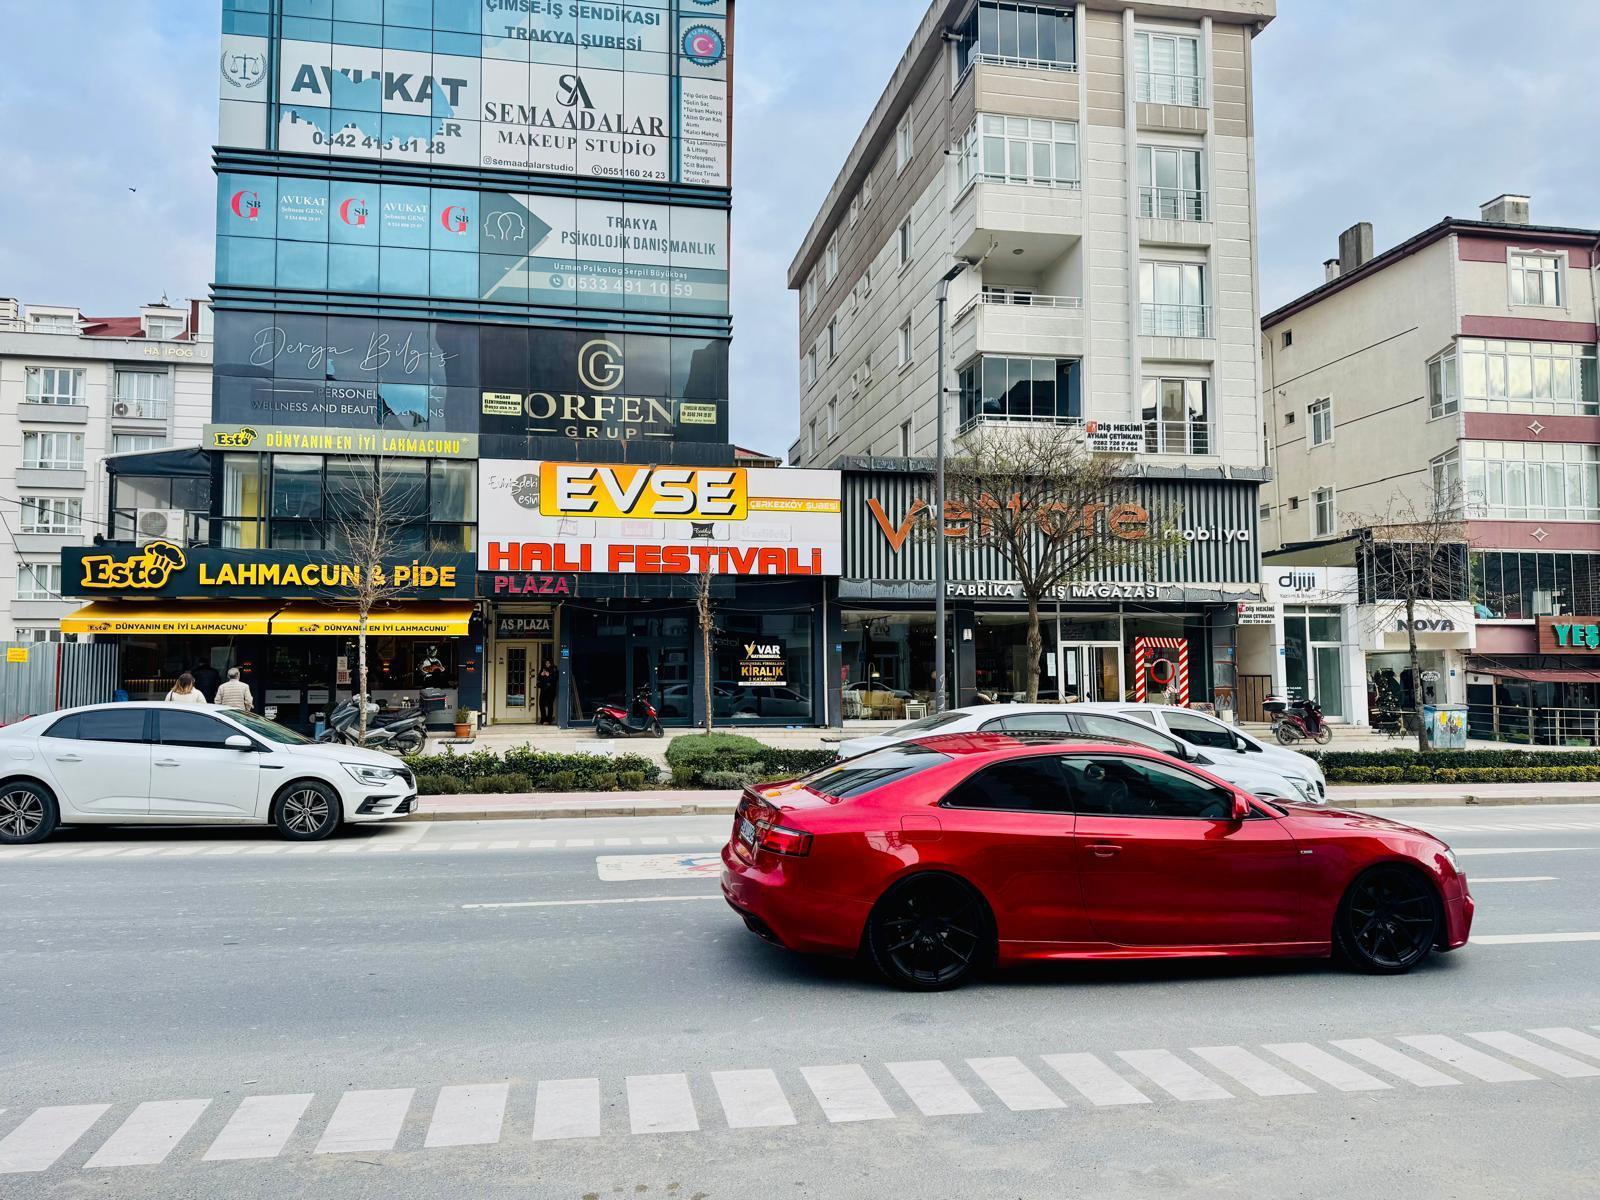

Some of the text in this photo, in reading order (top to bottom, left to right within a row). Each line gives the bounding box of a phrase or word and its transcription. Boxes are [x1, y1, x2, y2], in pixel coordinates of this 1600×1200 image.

[569, 4, 661, 26] SENDİKASI
[504, 26, 642, 51] TRAKYA ŞUBESİ
[484, 102, 665, 137] SEMA ADALAR
[497, 130, 656, 157] MAKEUP STUDİO
[492, 157, 574, 172] semaadalarstudio
[603, 167, 666, 180] 0551 160 24 23
[280, 195, 328, 206] AVUKAT
[383, 202, 428, 213] AVUKAT
[606, 216, 658, 231] TRAKYA
[561, 230, 716, 256] PSİKOLOJİK DANIŞMANLIK
[553, 262, 581, 272] Uzman
[583, 264, 623, 275] Psikolog
[624, 267, 649, 277] Serpil
[567, 276, 693, 297] 0533 491 10 59
[249, 326, 353, 370] Derya
[250, 400, 308, 412] WELLNESS
[311, 403, 337, 413] AND
[524, 392, 678, 426] ORFEN
[565, 426, 637, 438] GRUP
[1097, 422, 1142, 432] DİŞ HEKİMİ
[215, 431, 460, 454] Esto DÜNYANIN EN İYİ LAHMACUNU
[556, 465, 737, 514] EVSE
[488, 542, 822, 575] HALI FESTİVALİ
[82, 554, 457, 588] Esto LAHMACUN & PİDE
[494, 575, 570, 594] PLAZA
[946, 582, 1015, 596] FABRİKA
[115, 622, 160, 630] DÜNYANIN
[177, 622, 189, 630] İYİ
[501, 618, 550, 630] AS PLAZA
[1397, 619, 1456, 631] NOVA
[1553, 624, 1600, 650] YEŞ
[757, 644, 780, 654] VAR
[741, 665, 784, 676] KİRALIK
